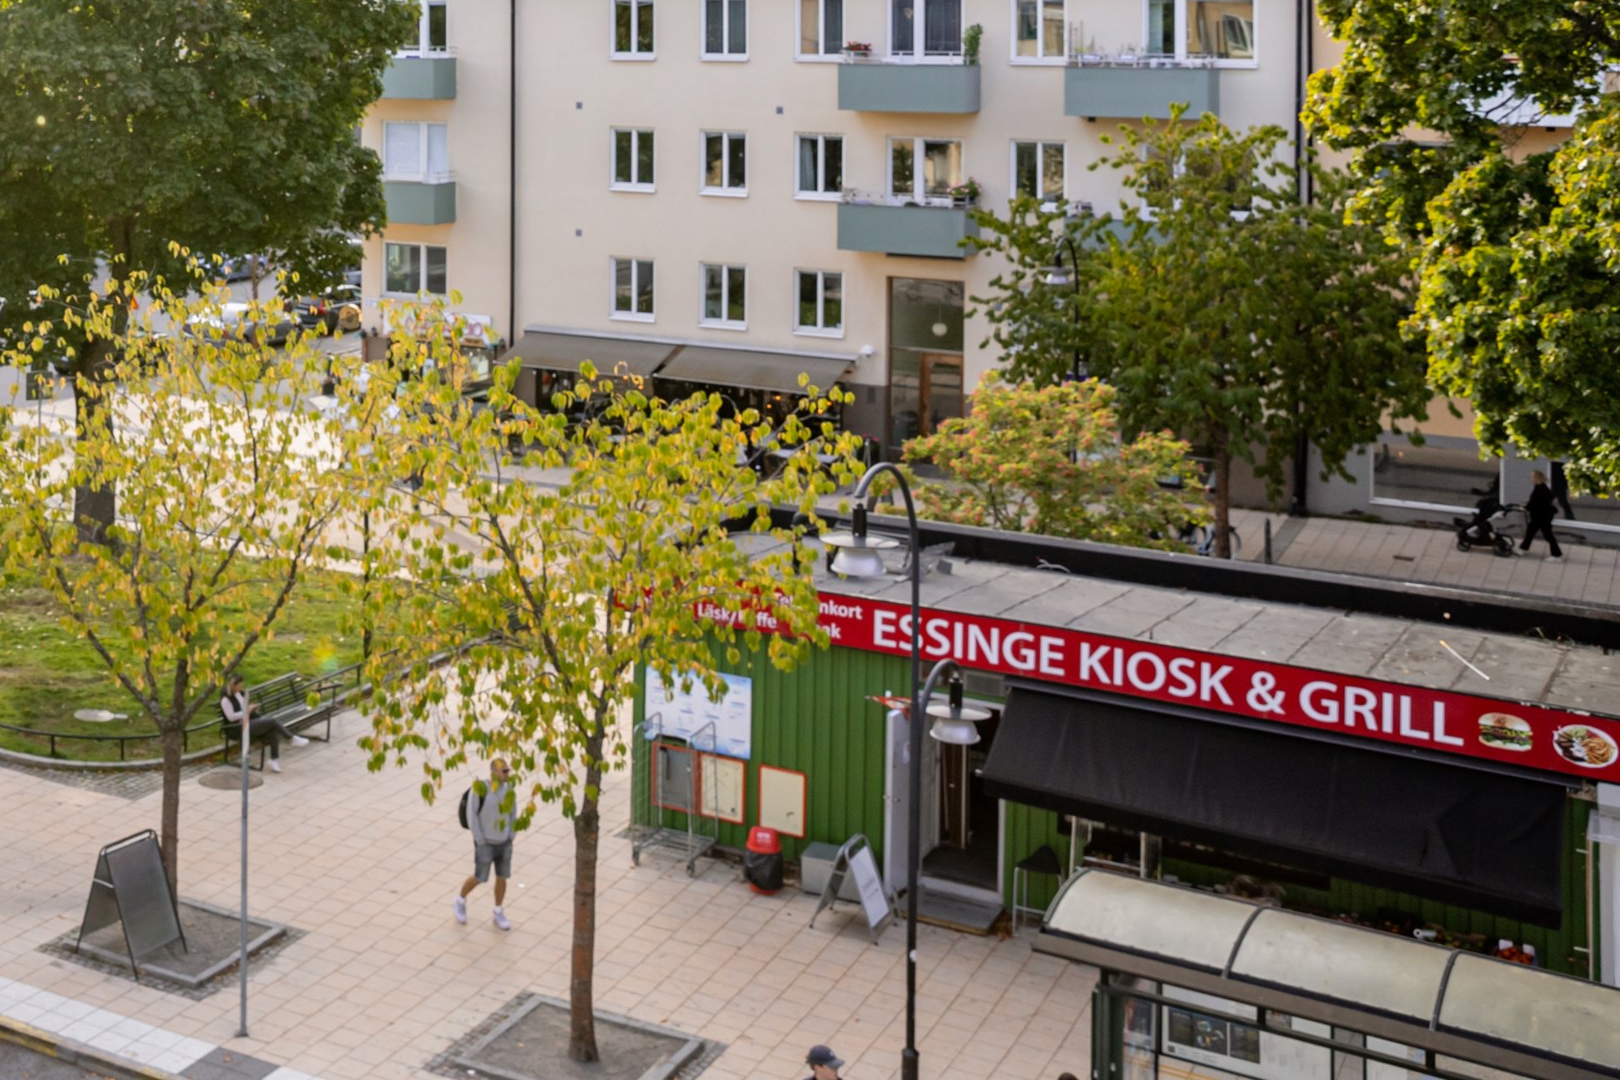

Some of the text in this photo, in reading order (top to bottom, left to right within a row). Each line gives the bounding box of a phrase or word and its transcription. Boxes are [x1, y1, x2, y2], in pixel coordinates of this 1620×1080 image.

[873, 609, 1464, 747] ESSINGE KIOSK & GRILL
